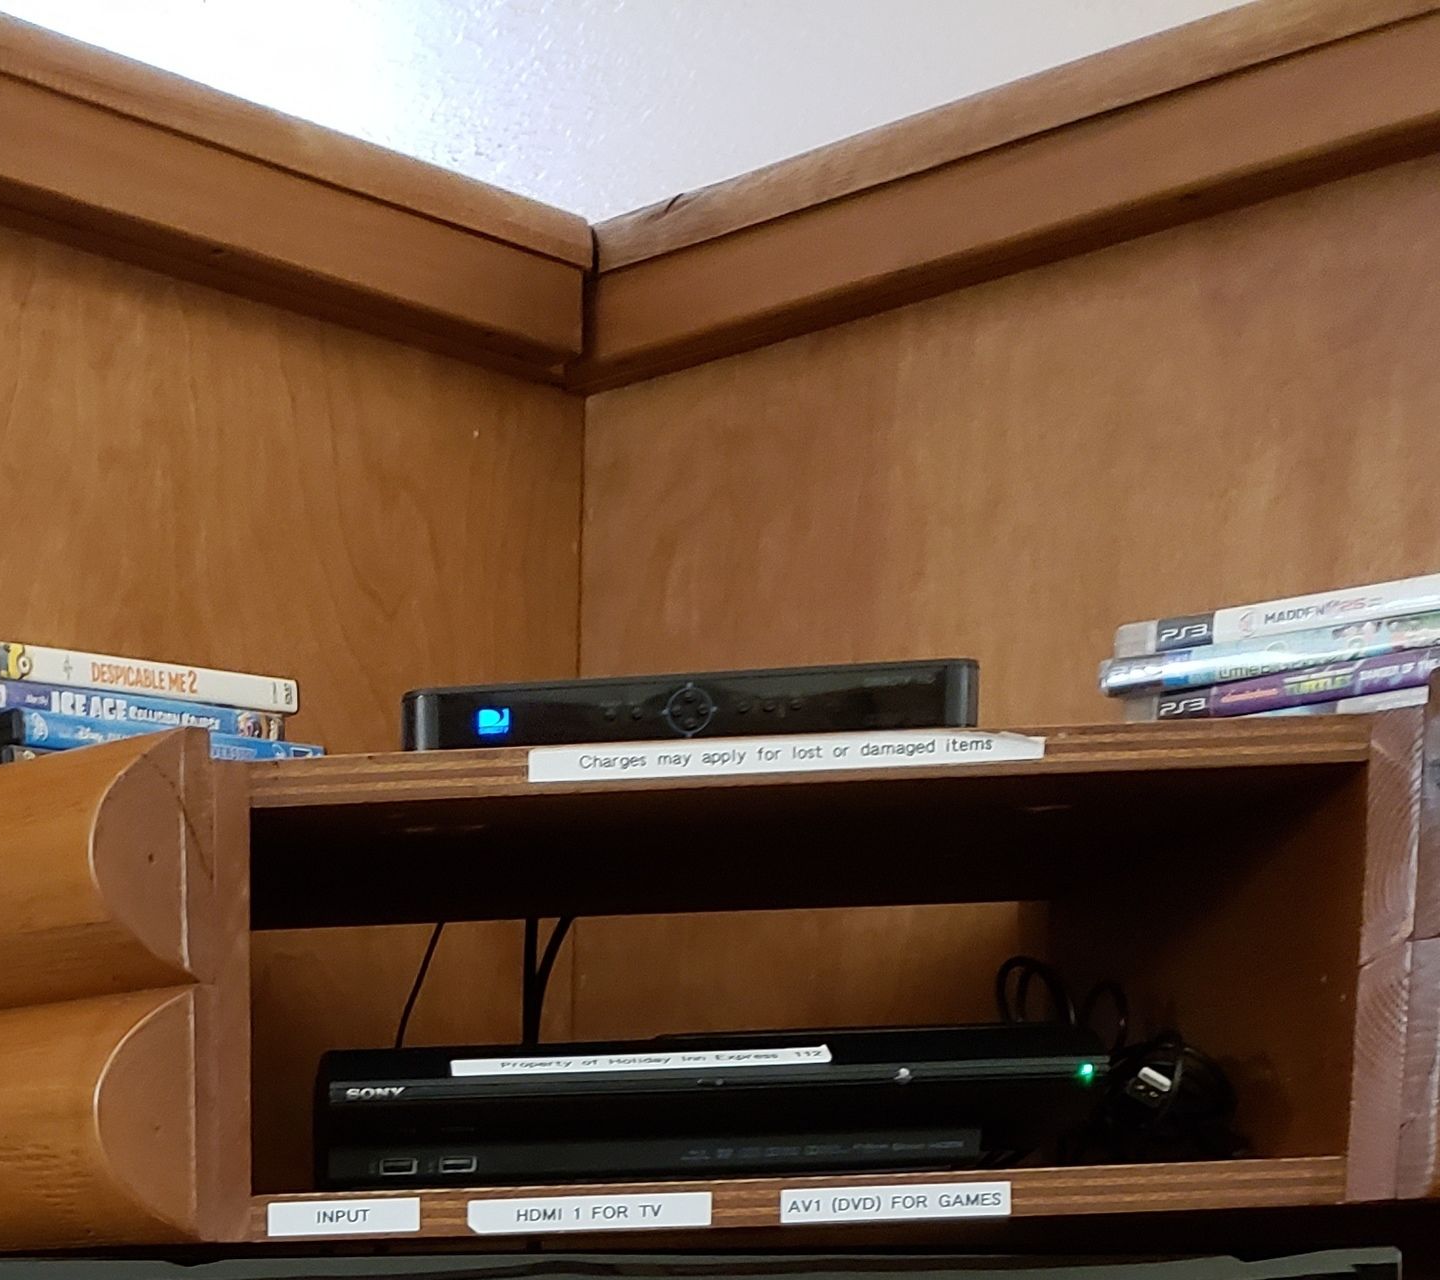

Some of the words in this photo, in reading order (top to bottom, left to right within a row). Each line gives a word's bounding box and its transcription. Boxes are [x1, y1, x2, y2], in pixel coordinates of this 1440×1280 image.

[1160, 624, 1208, 641] PS3
[91, 662, 164, 691] DESPICABLE
[168, 671, 186, 693] ME
[188, 669, 198, 694] 2
[51, 691, 87, 716] ICE
[89, 696, 127, 721] AGE
[1160, 698, 1205, 715] PS3
[579, 754, 647, 769] Charges
[657, 752, 691, 768] may
[702, 749, 746, 765] apply
[757, 747, 782, 761] for
[792, 745, 823, 759] lost
[833, 745, 849, 758] or
[861, 739, 935, 757] damaged
[946, 738, 993, 752] items
[501, 1060, 573, 1069] Property
[582, 1058, 597, 1066] of
[609, 1056, 671, 1065] Holiday
[681, 1054, 706, 1063] Inn
[715, 1053, 779, 1062] Express
[346, 1087, 405, 1099] SONY
[788, 1199, 821, 1213] AV1
[832, 1196, 882, 1213] (DVD)
[891, 1195, 928, 1209] FOR
[939, 1192, 1002, 1207] GAMES
[316, 1208, 370, 1224] INPUT
[516, 1207, 562, 1222] HDMI
[574, 1207, 581, 1220] 1
[591, 1205, 629, 1219] FOR
[639, 1204, 662, 1217] TV
